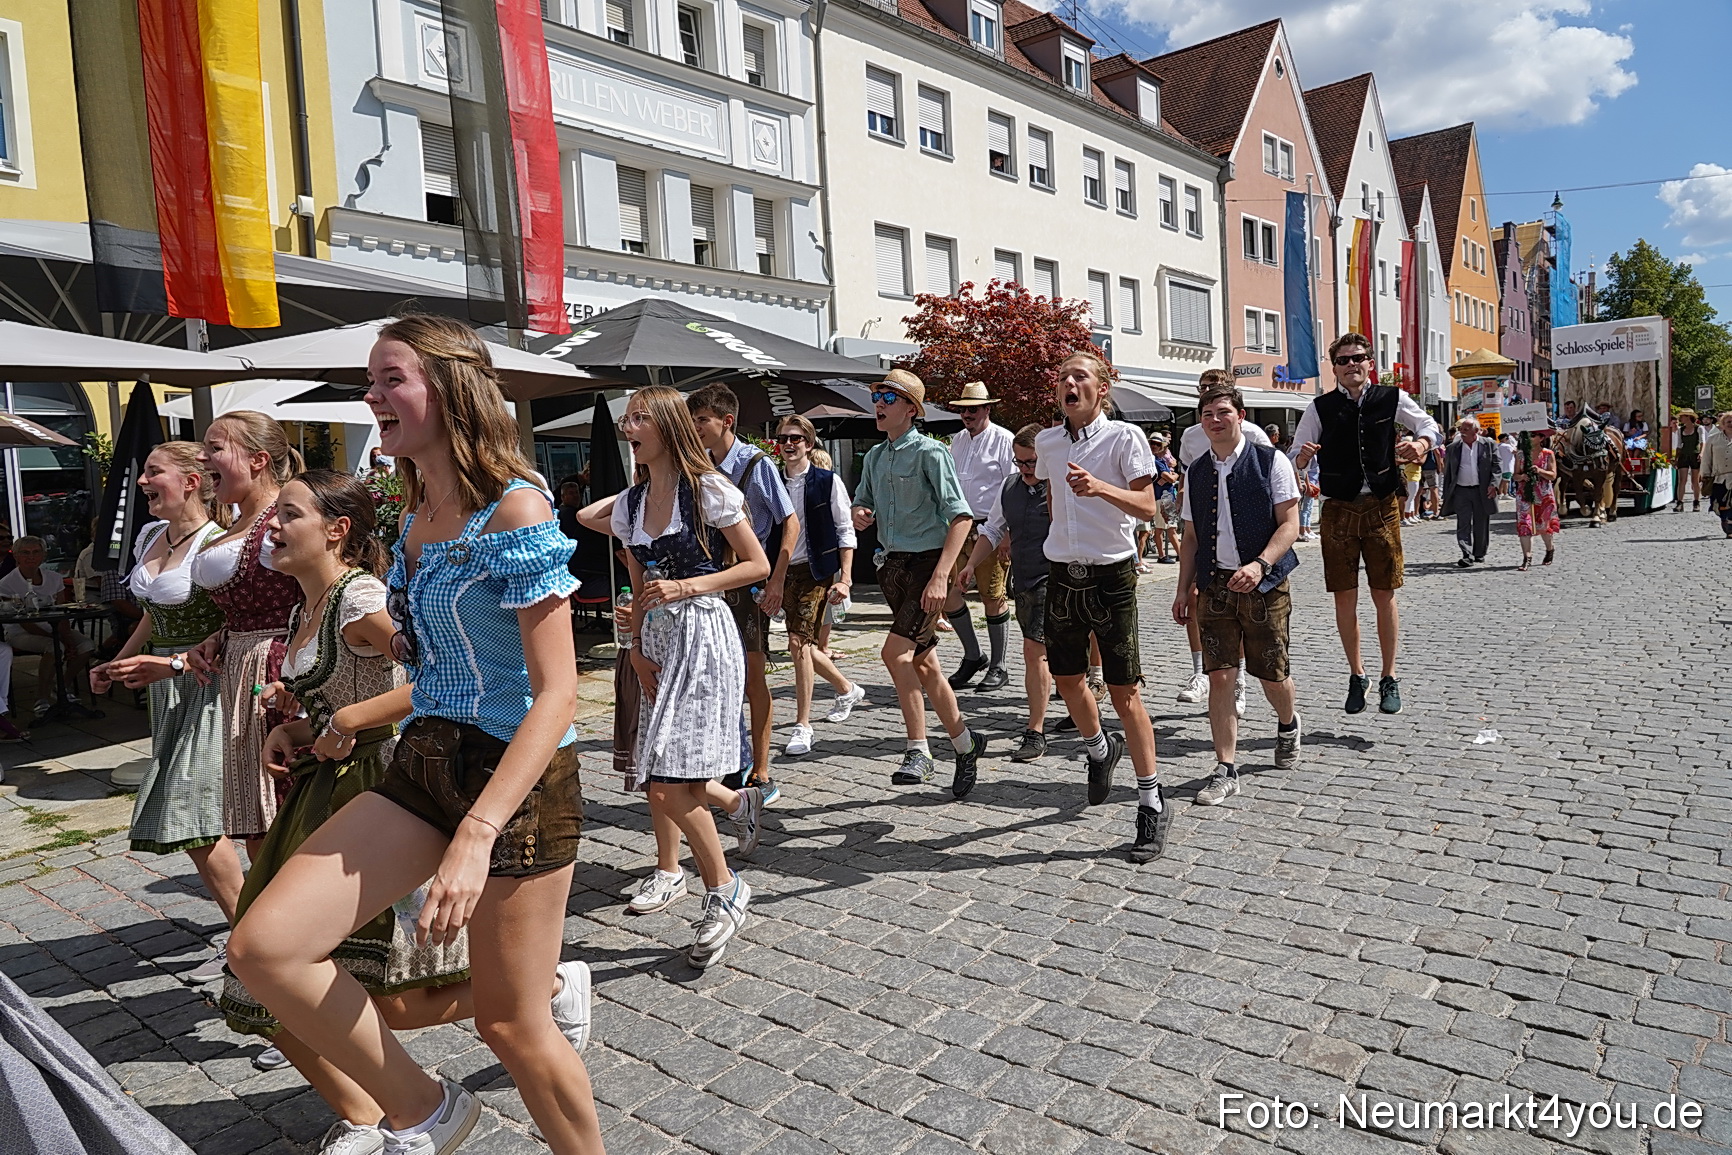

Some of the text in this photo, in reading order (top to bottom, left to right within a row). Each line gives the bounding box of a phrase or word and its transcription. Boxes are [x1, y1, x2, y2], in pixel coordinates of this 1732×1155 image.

[550, 69, 715, 140] RILLEN WEBER
[564, 302, 594, 319] ZER
[1556, 336, 1626, 356] Schloss-Spiele
